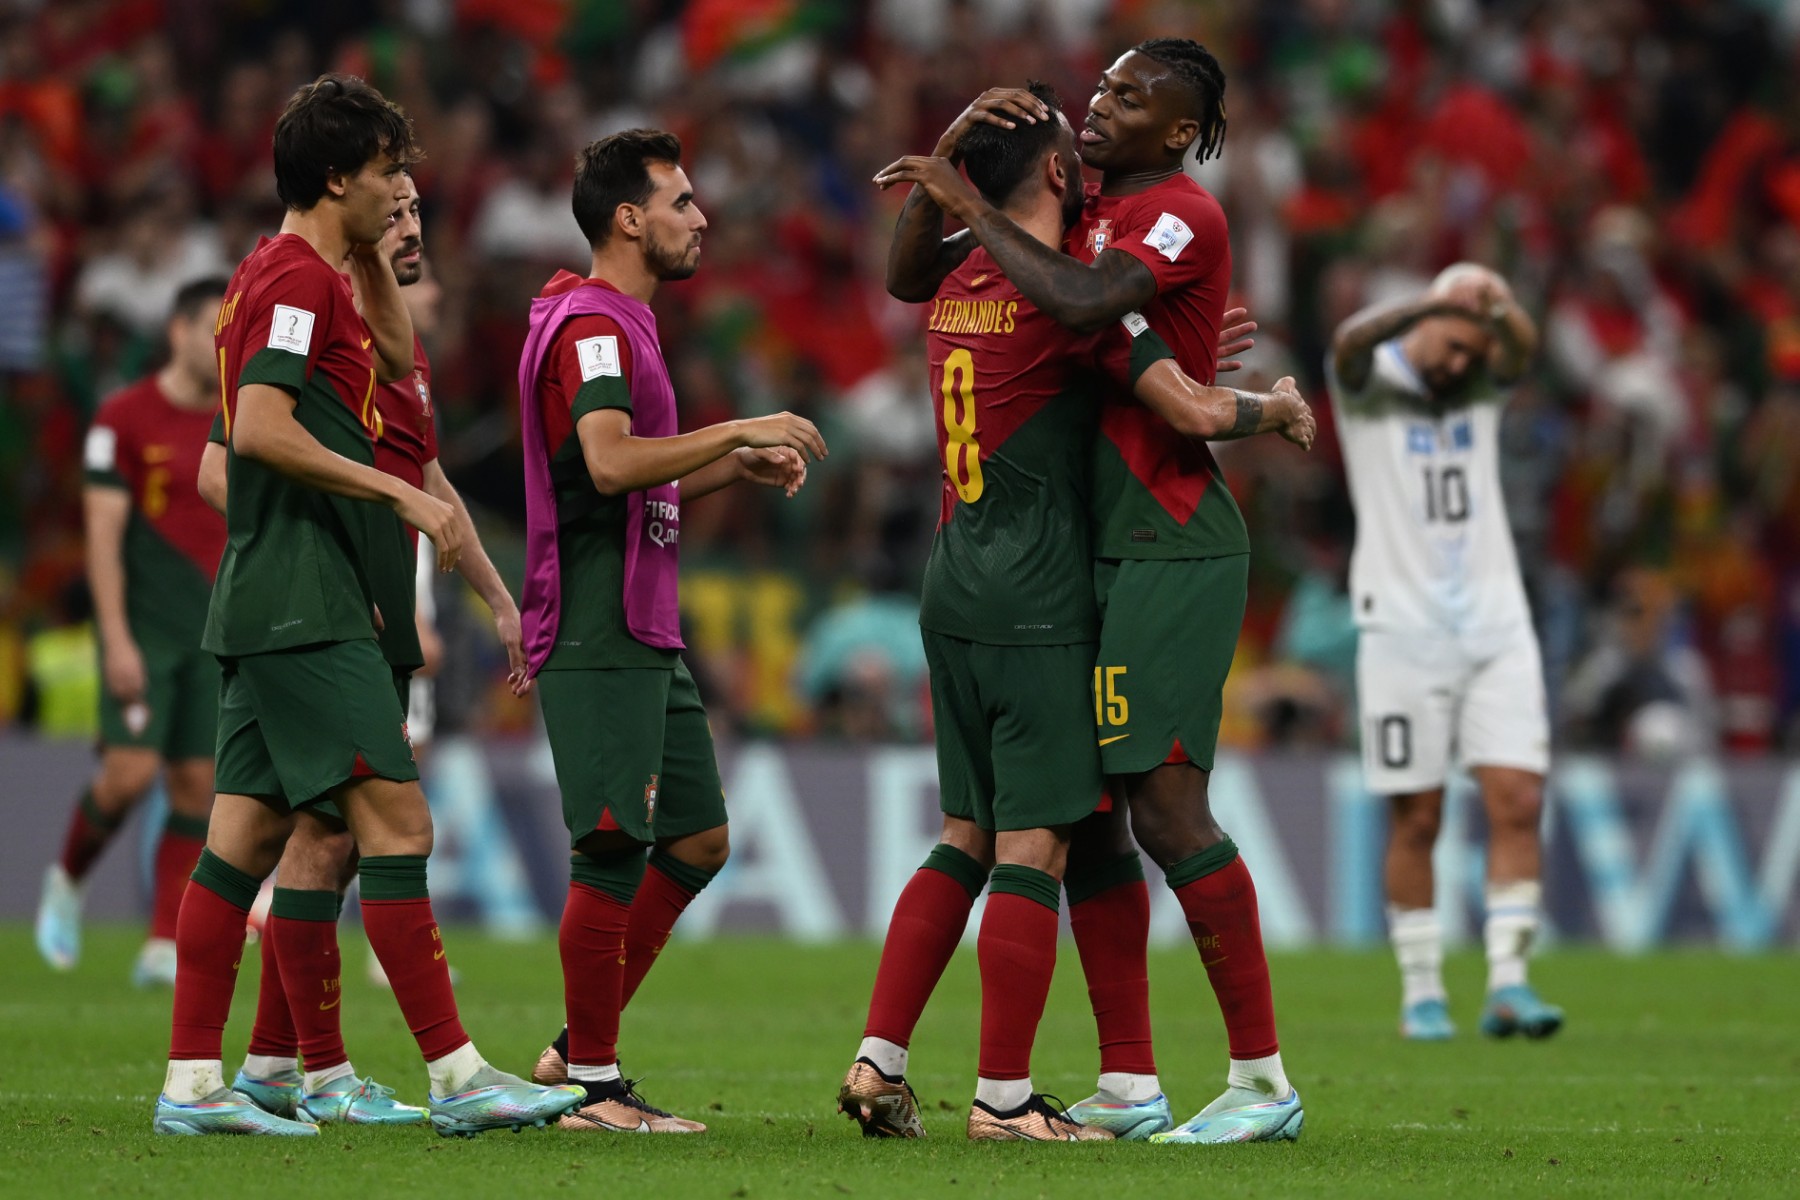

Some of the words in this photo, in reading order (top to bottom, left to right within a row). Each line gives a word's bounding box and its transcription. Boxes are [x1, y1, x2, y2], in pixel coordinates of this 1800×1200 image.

[941, 348, 984, 504] 8
[1422, 464, 1470, 523] 10
[1094, 665, 1129, 726] 15
